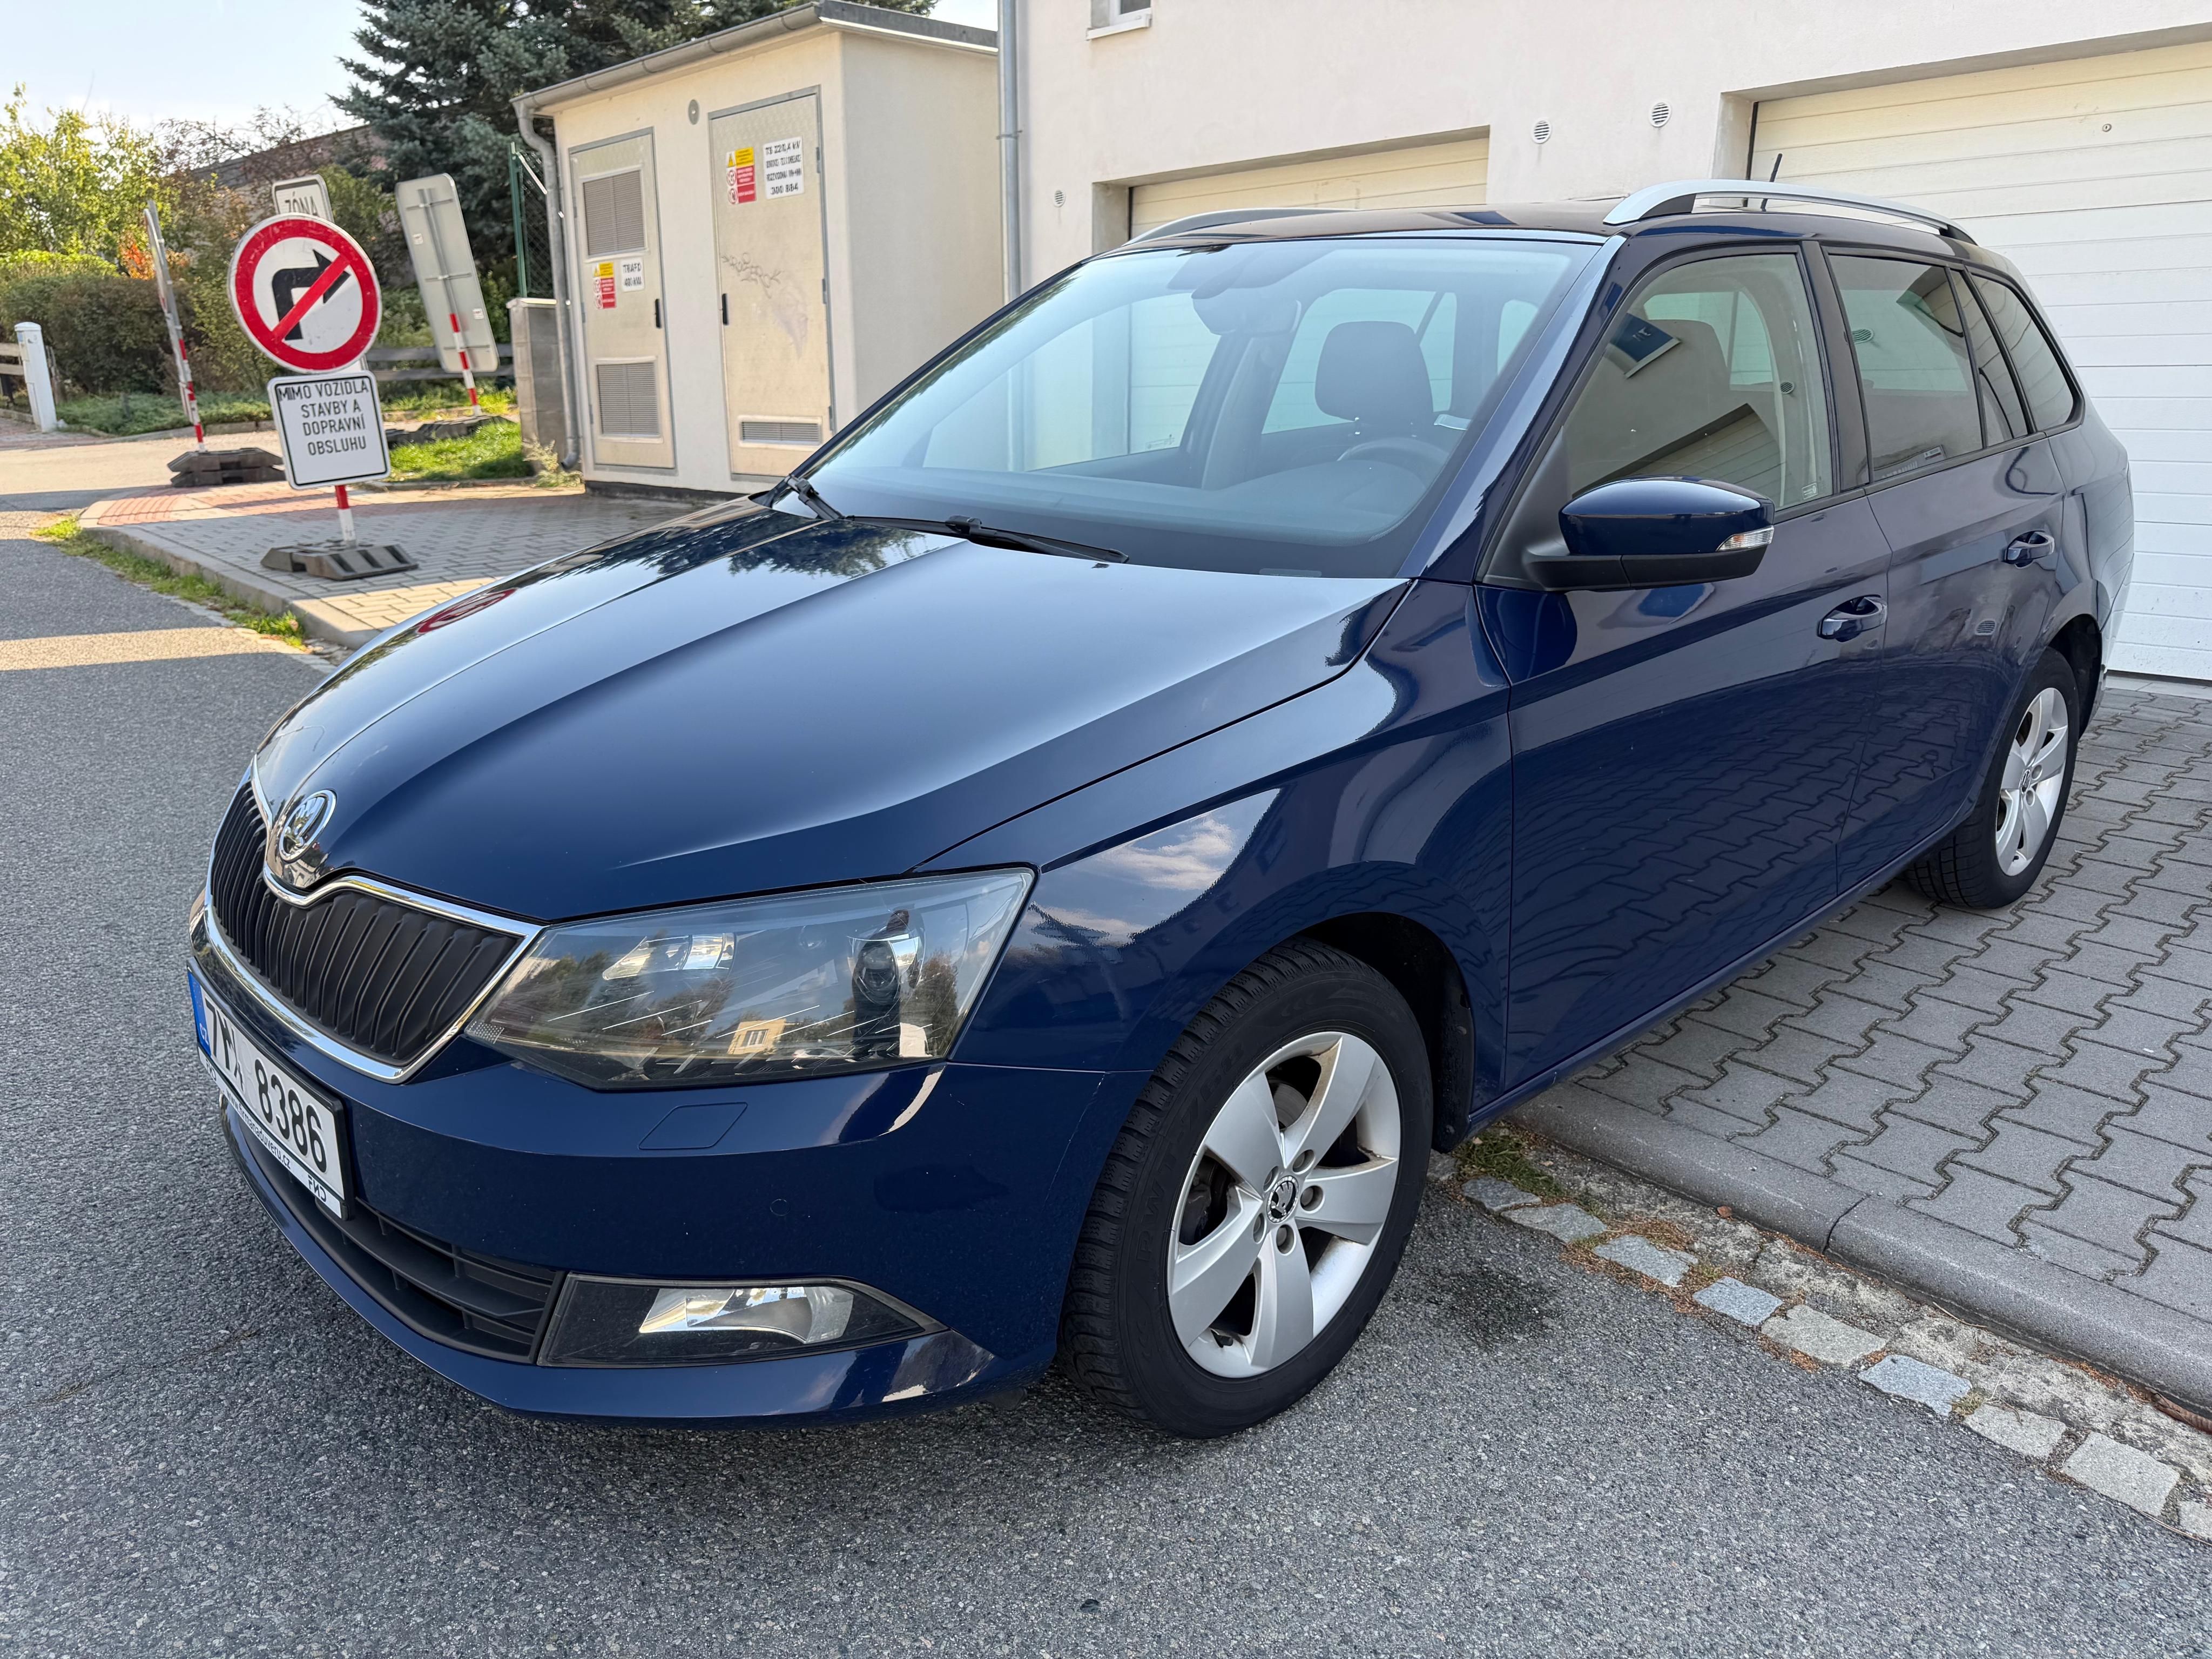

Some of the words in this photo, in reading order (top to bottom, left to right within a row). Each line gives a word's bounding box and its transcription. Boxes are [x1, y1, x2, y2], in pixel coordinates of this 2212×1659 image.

[276, 385, 312, 402] MIMO
[315, 380, 369, 397] VOZIDLA
[301, 400, 348, 418] STAVBY
[353, 399, 361, 413] A
[302, 413, 366, 436] DOPRAVNÍ
[307, 436, 367, 456] OBSLUHU
[199, 1022, 209, 1046] CZ
[254, 1058, 327, 1174] 8386
